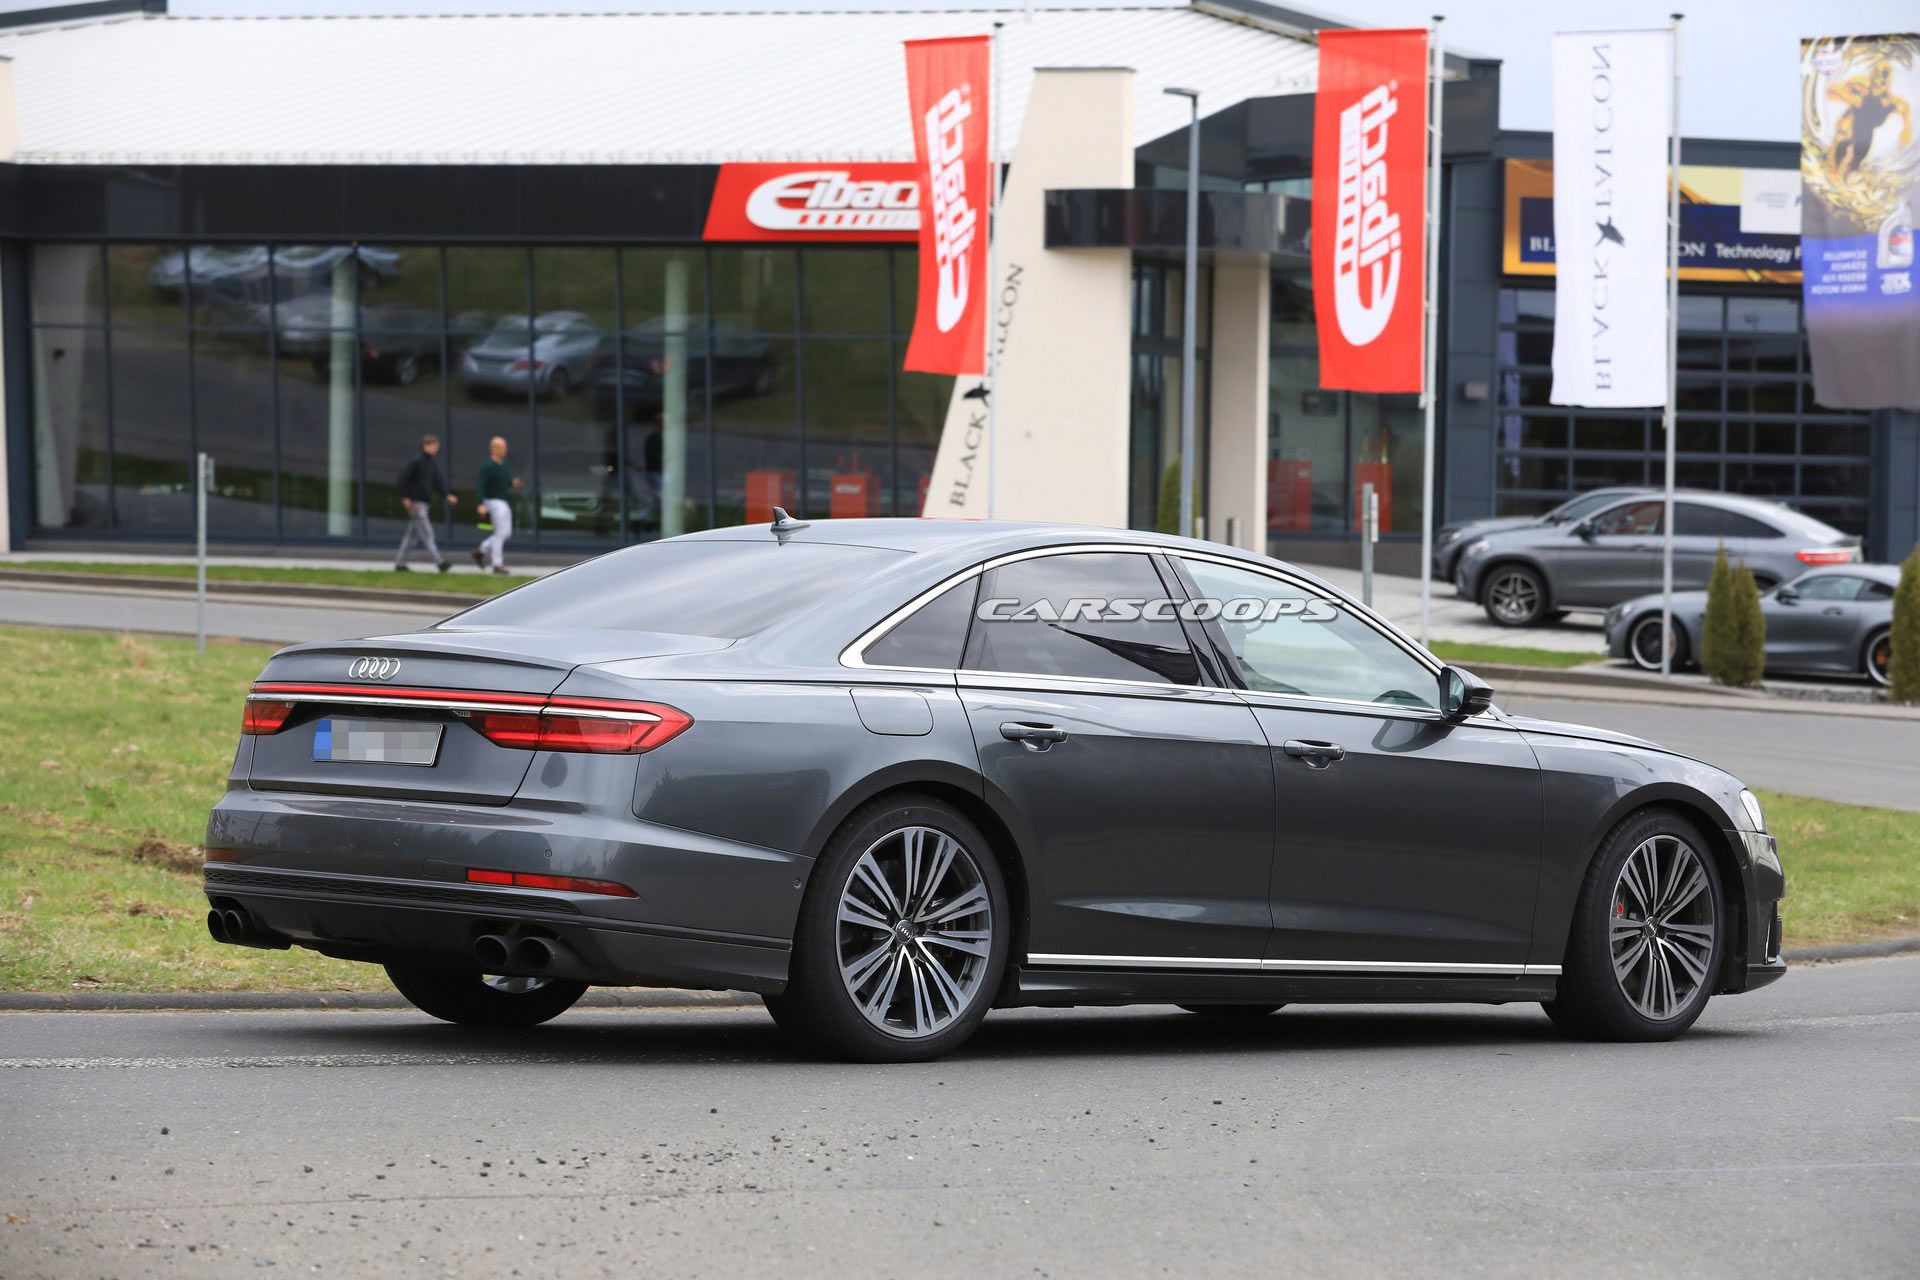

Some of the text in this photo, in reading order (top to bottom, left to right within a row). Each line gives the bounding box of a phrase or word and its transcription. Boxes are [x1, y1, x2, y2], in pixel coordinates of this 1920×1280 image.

[745, 171, 920, 230] Eibac
[1714, 241, 1793, 264] Technology
[950, 412, 987, 507] BLACK
